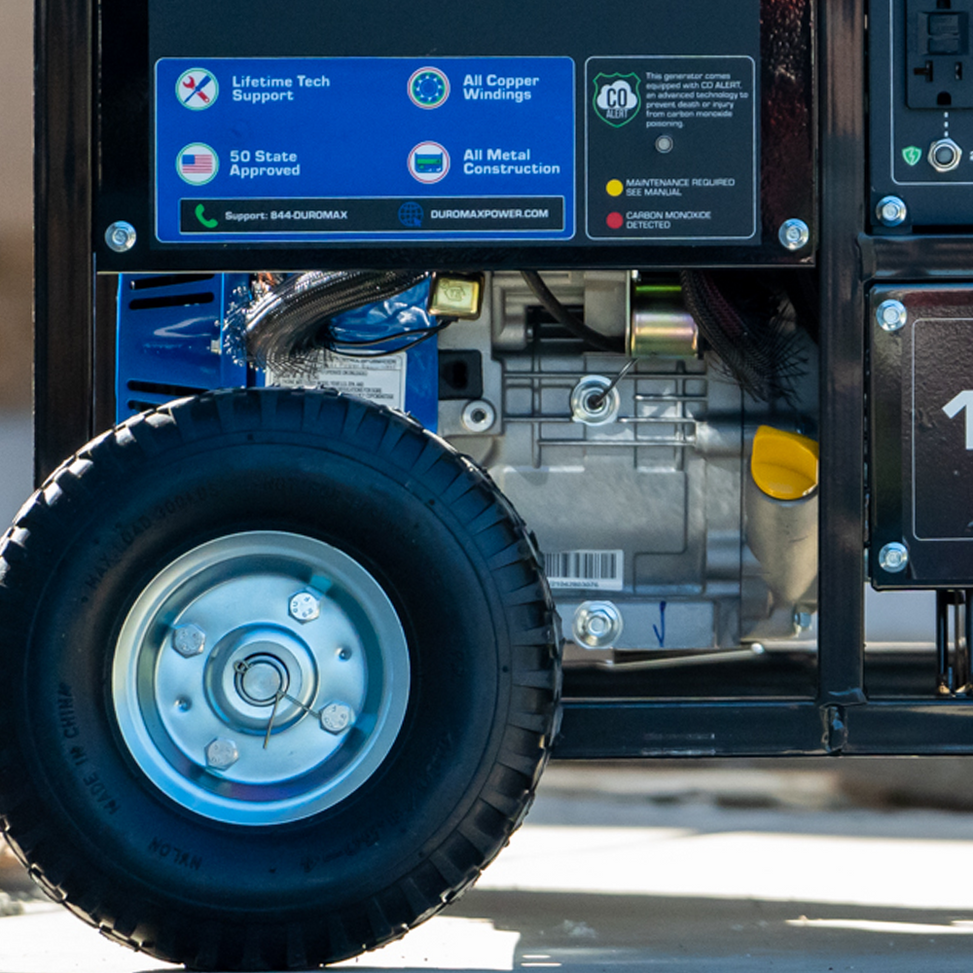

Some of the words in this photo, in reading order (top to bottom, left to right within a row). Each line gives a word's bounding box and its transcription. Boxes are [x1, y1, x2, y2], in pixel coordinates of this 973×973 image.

[233, 76, 292, 87] Lifetime
[297, 75, 330, 87] Tech
[464, 75, 482, 87] All
[487, 75, 540, 89] Copper
[645, 72, 662, 80] This
[664, 73, 703, 81] generator
[645, 82, 681, 90] equipped
[682, 81, 699, 89] with
[701, 81, 713, 89] CO
[233, 89, 293, 103] Support
[464, 87, 532, 103] Windings
[606, 87, 627, 108] CO
[606, 108, 628, 119] ALERT
[230, 151, 250, 162] 50
[255, 151, 297, 161] State
[464, 149, 482, 161] All
[487, 149, 530, 160] Metal
[230, 164, 300, 178] Approved
[464, 161, 561, 175] Construction
[226, 211, 267, 221] Support:
[431, 209, 548, 218] DUROMAXPOWER.COM
